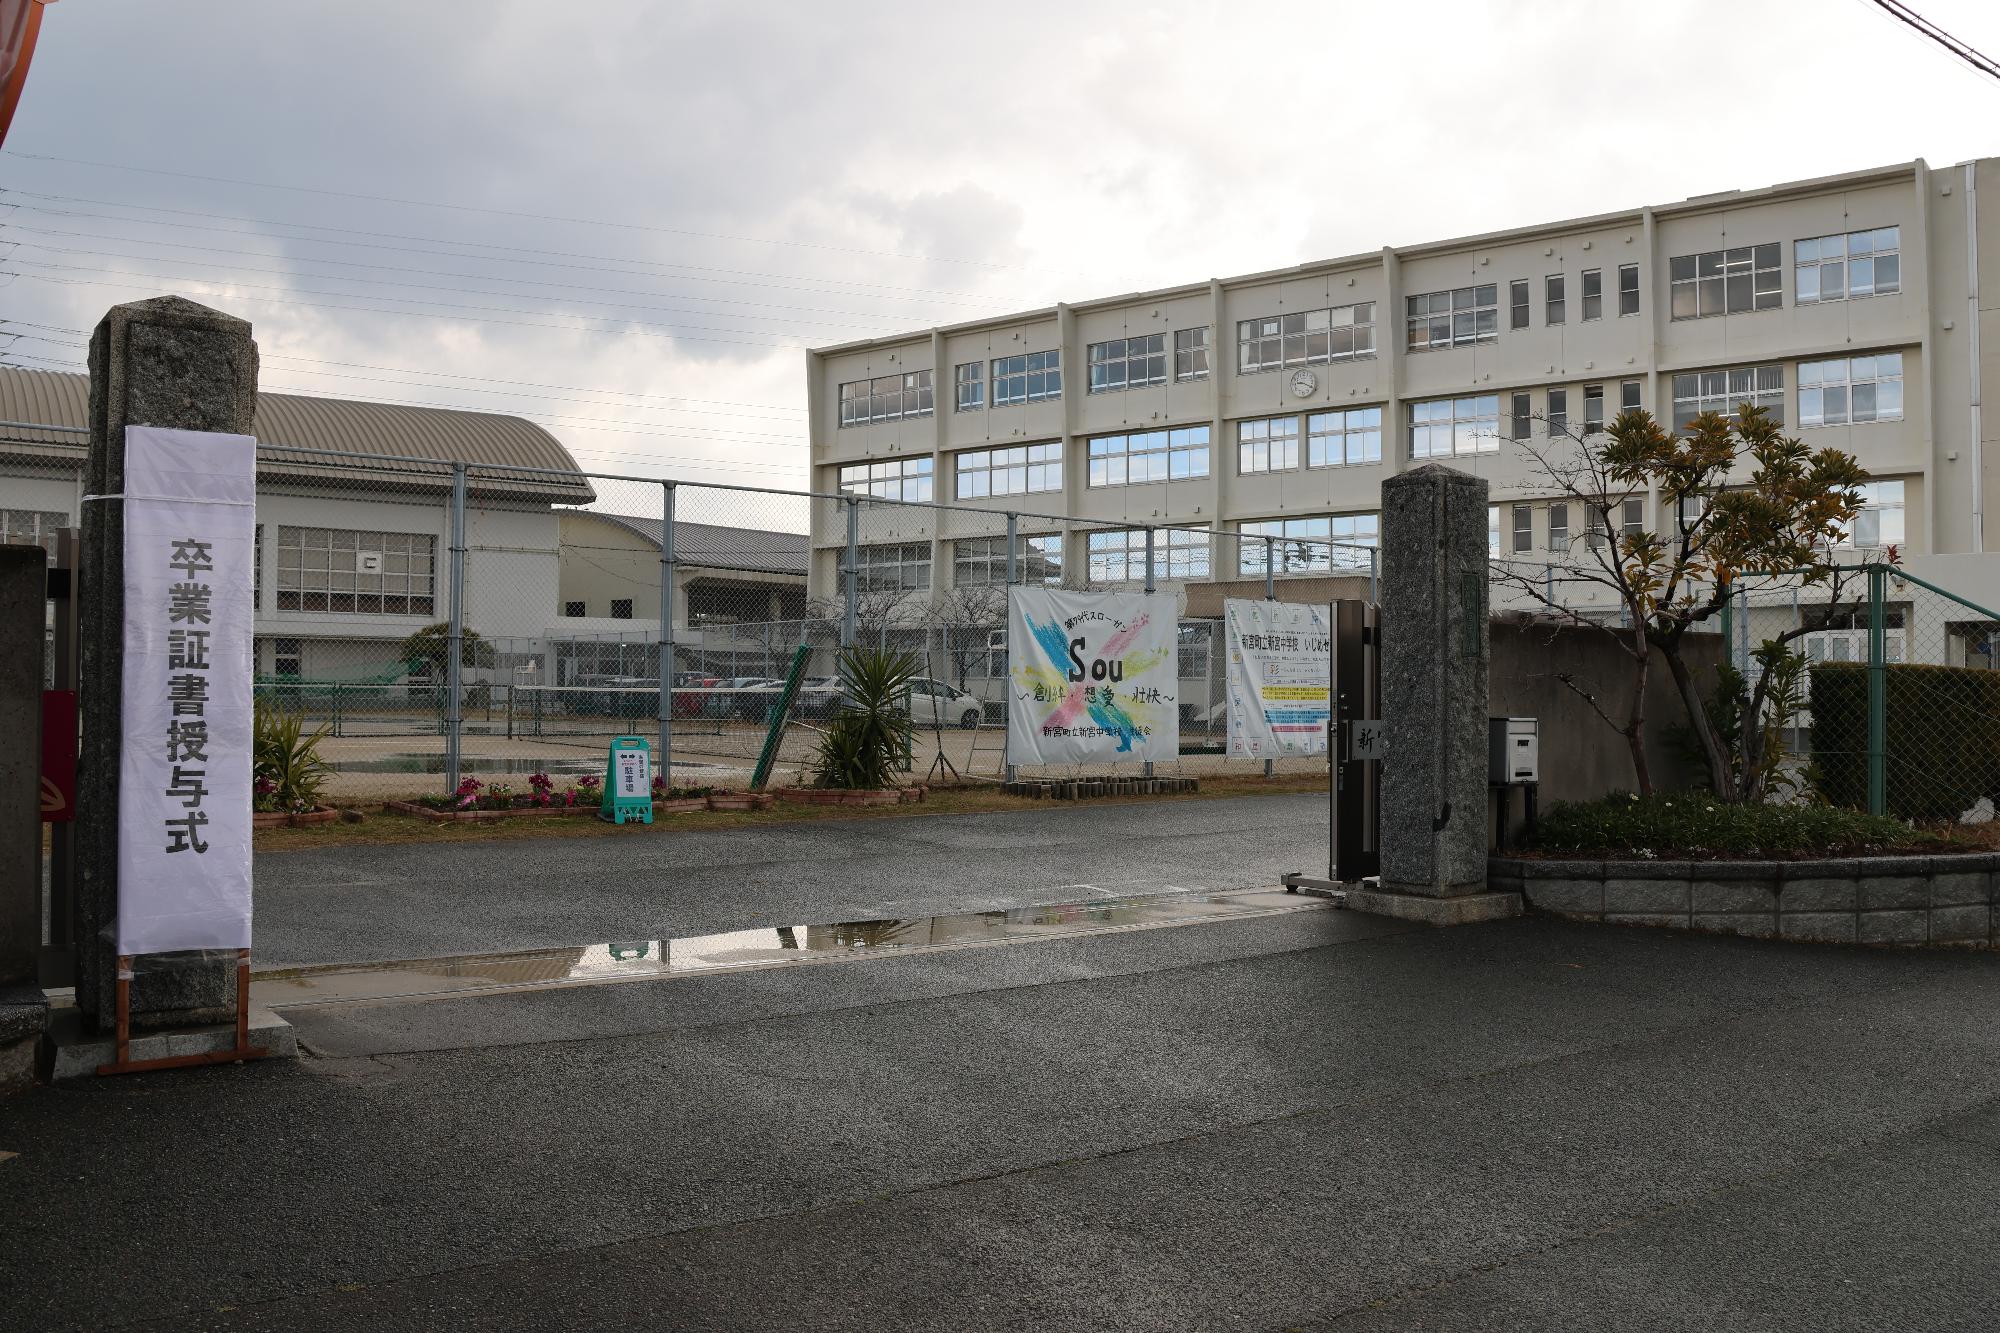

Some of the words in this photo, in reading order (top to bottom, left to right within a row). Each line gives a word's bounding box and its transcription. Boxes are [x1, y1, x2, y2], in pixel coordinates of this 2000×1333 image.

[1241, 634, 1299, 653] 新宮町立新宮中学校
[1068, 636, 1123, 683] Sou
[164, 537, 213, 855] 卒業証書授与式
[1043, 726, 1122, 738] 新宮町立新宮中学校
[624, 767, 634, 792] 駐車場
